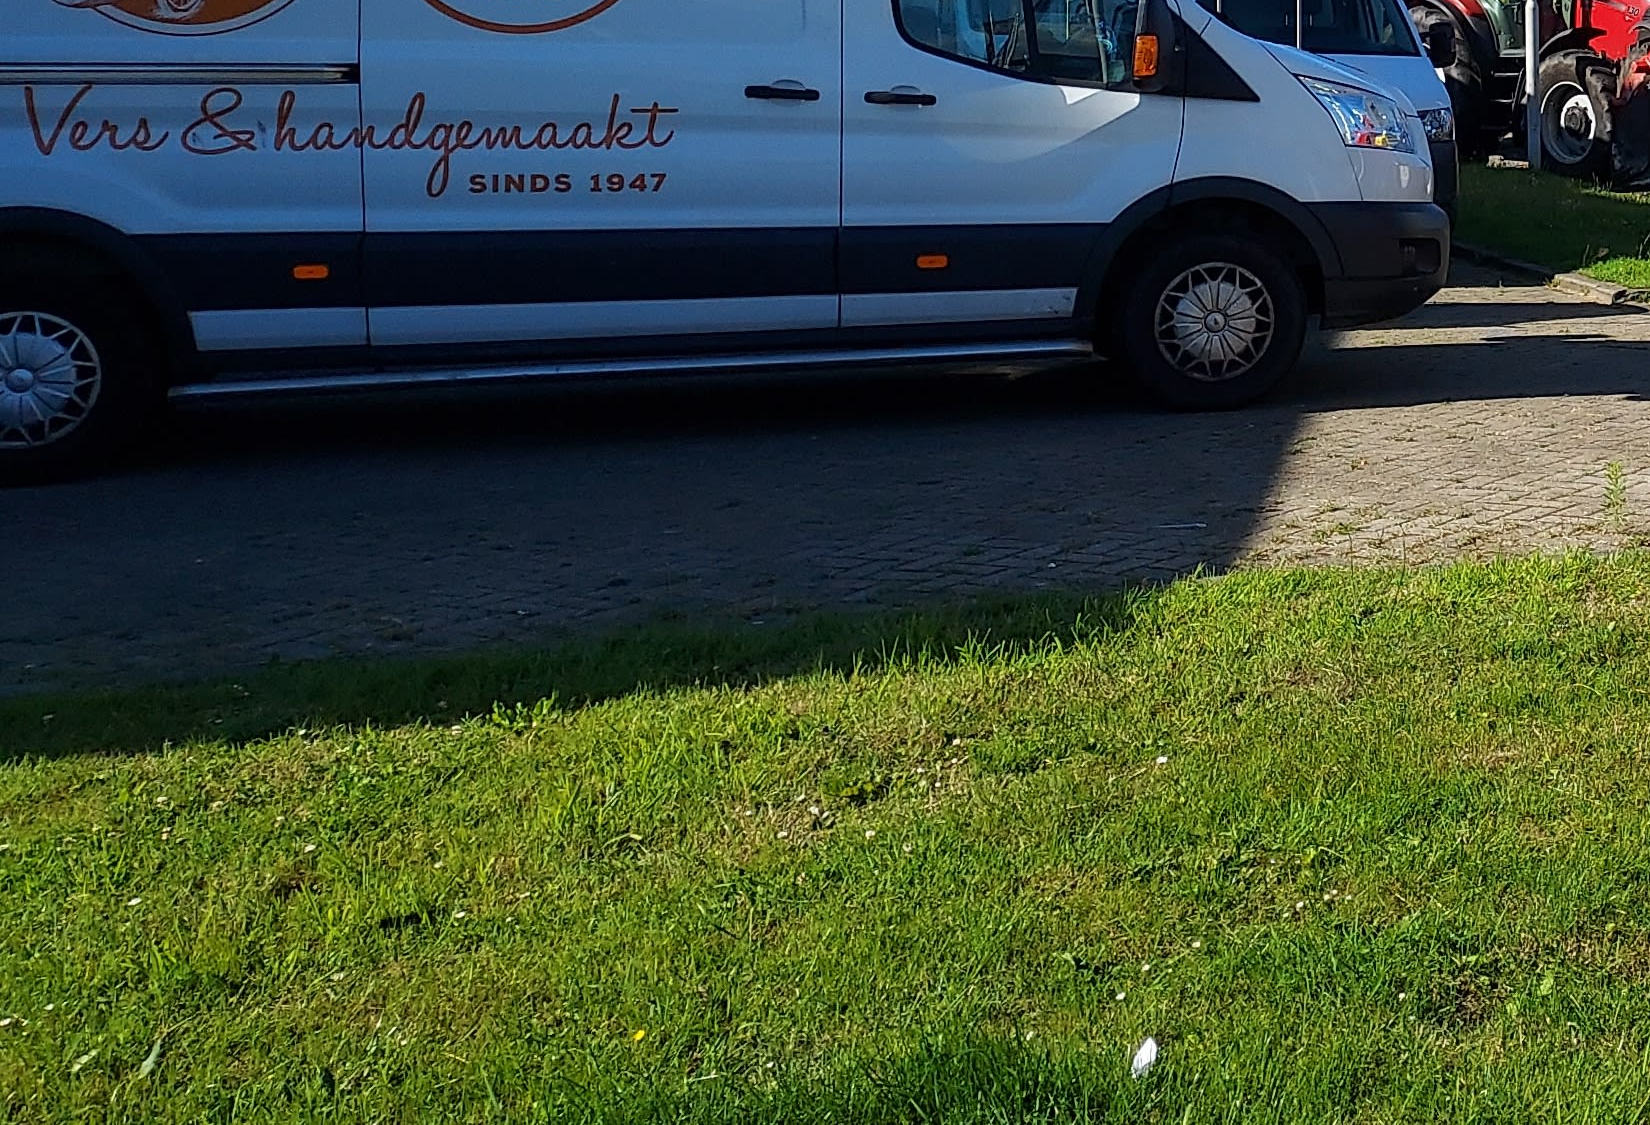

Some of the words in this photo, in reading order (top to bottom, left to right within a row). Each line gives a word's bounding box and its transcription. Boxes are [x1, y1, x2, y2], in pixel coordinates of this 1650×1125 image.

[25, 84, 168, 155] Vers
[180, 87, 257, 155] &
[275, 90, 679, 198] handgemaakt
[469, 173, 579, 194] SINDS
[589, 172, 667, 193] 1947
